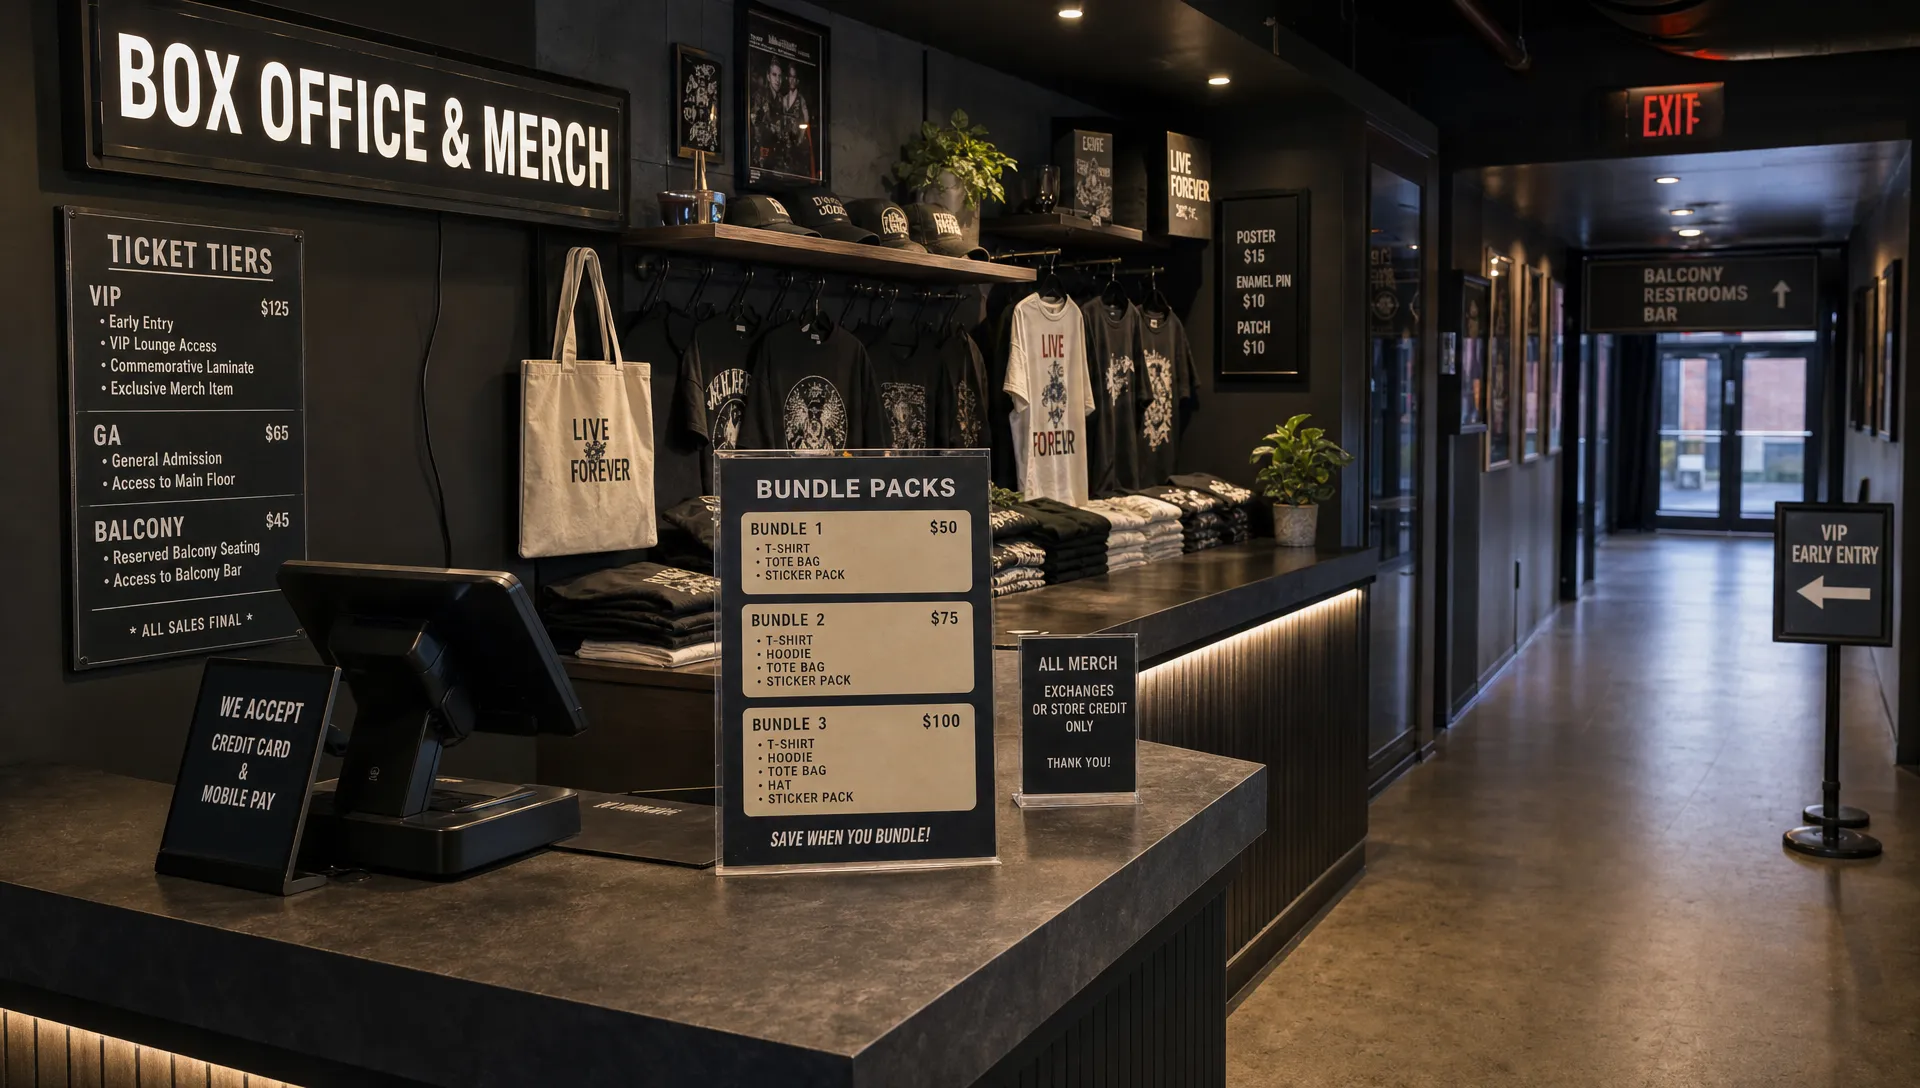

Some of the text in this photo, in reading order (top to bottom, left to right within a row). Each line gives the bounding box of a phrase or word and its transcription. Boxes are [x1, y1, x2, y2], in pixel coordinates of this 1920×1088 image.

[118, 32, 609, 191] BOX OFFICE & MERCH
[1643, 92, 1700, 137] EXIT
[1170, 149, 1192, 175] LIVE
[1170, 175, 1211, 202] FOREVER
[1236, 229, 1276, 244] POSTER
[107, 234, 273, 275] TICKET TIERS
[1243, 248, 1265, 264] $15
[1236, 274, 1292, 289] ENAMEL PIN
[1643, 266, 1724, 283] BALCONY
[89, 284, 122, 307] VIP
[1243, 293, 1265, 309] $10
[1643, 285, 1748, 303] RESTROOMS
[260, 298, 289, 317] $125
[1643, 306, 1678, 322] BAR
[109, 314, 174, 333] Early Entry
[1237, 320, 1271, 334] PATCH
[110, 337, 217, 354] VIP Lounge Access
[1041, 334, 1064, 358] LIVE
[1243, 339, 1265, 356] $10
[110, 358, 254, 374] Commemorative Laminate
[111, 381, 233, 395] Exclusive Merch Item
[93, 424, 121, 446] GA
[265, 424, 289, 443] $65
[573, 418, 610, 441] LIVE
[112, 451, 222, 468] General Admission
[571, 458, 631, 483] FOREVER
[112, 472, 236, 490] Access to Main Floor
[756, 477, 956, 499] BUNDLE PACKS
[265, 511, 289, 530] $45
[750, 522, 823, 536] BUNDLE 1
[930, 519, 958, 535] $50
[94, 516, 184, 543] BALCONY
[1821, 524, 1848, 541] VIP
[113, 541, 260, 565] Reserved Balcony Seating
[765, 543, 810, 554] T-SHIRT
[1792, 545, 1879, 565] EARLY ENTRY
[765, 556, 820, 567] TOTE BAG
[113, 564, 242, 588] Access to Balcony Bar
[765, 569, 845, 581] STICKER PACK
[141, 613, 242, 638] ALL SALES FINAL
[751, 613, 825, 627] BUNDLE 2
[931, 610, 958, 626] $75
[766, 635, 813, 646] T-SHIRT
[766, 649, 811, 660] HOODIE
[766, 662, 825, 673] TOTE BAG
[1038, 656, 1118, 672] ALL MERCH
[766, 675, 851, 687] STICKER PACK
[1044, 684, 1114, 698] EXCHANGES
[220, 695, 304, 724] WE ACCEPT
[1032, 702, 1127, 716] OR STORE CREDIT
[752, 716, 827, 732] BUNDLE 3
[922, 713, 961, 730] $100
[1065, 720, 1094, 733] ONLY
[211, 733, 291, 758] CREDIT CARD
[767, 738, 815, 750] T-SHIRT
[768, 752, 813, 763] HOODIE
[1047, 756, 1111, 769] THANK YOU!
[238, 762, 248, 781] &
[768, 765, 827, 777] TOTE BAG
[768, 780, 792, 791] HAT
[201, 784, 276, 811] MOBILE PAY
[768, 791, 854, 804] STICKER PACK
[770, 826, 931, 848] SAVE WHEN YOU BUNDLE!
